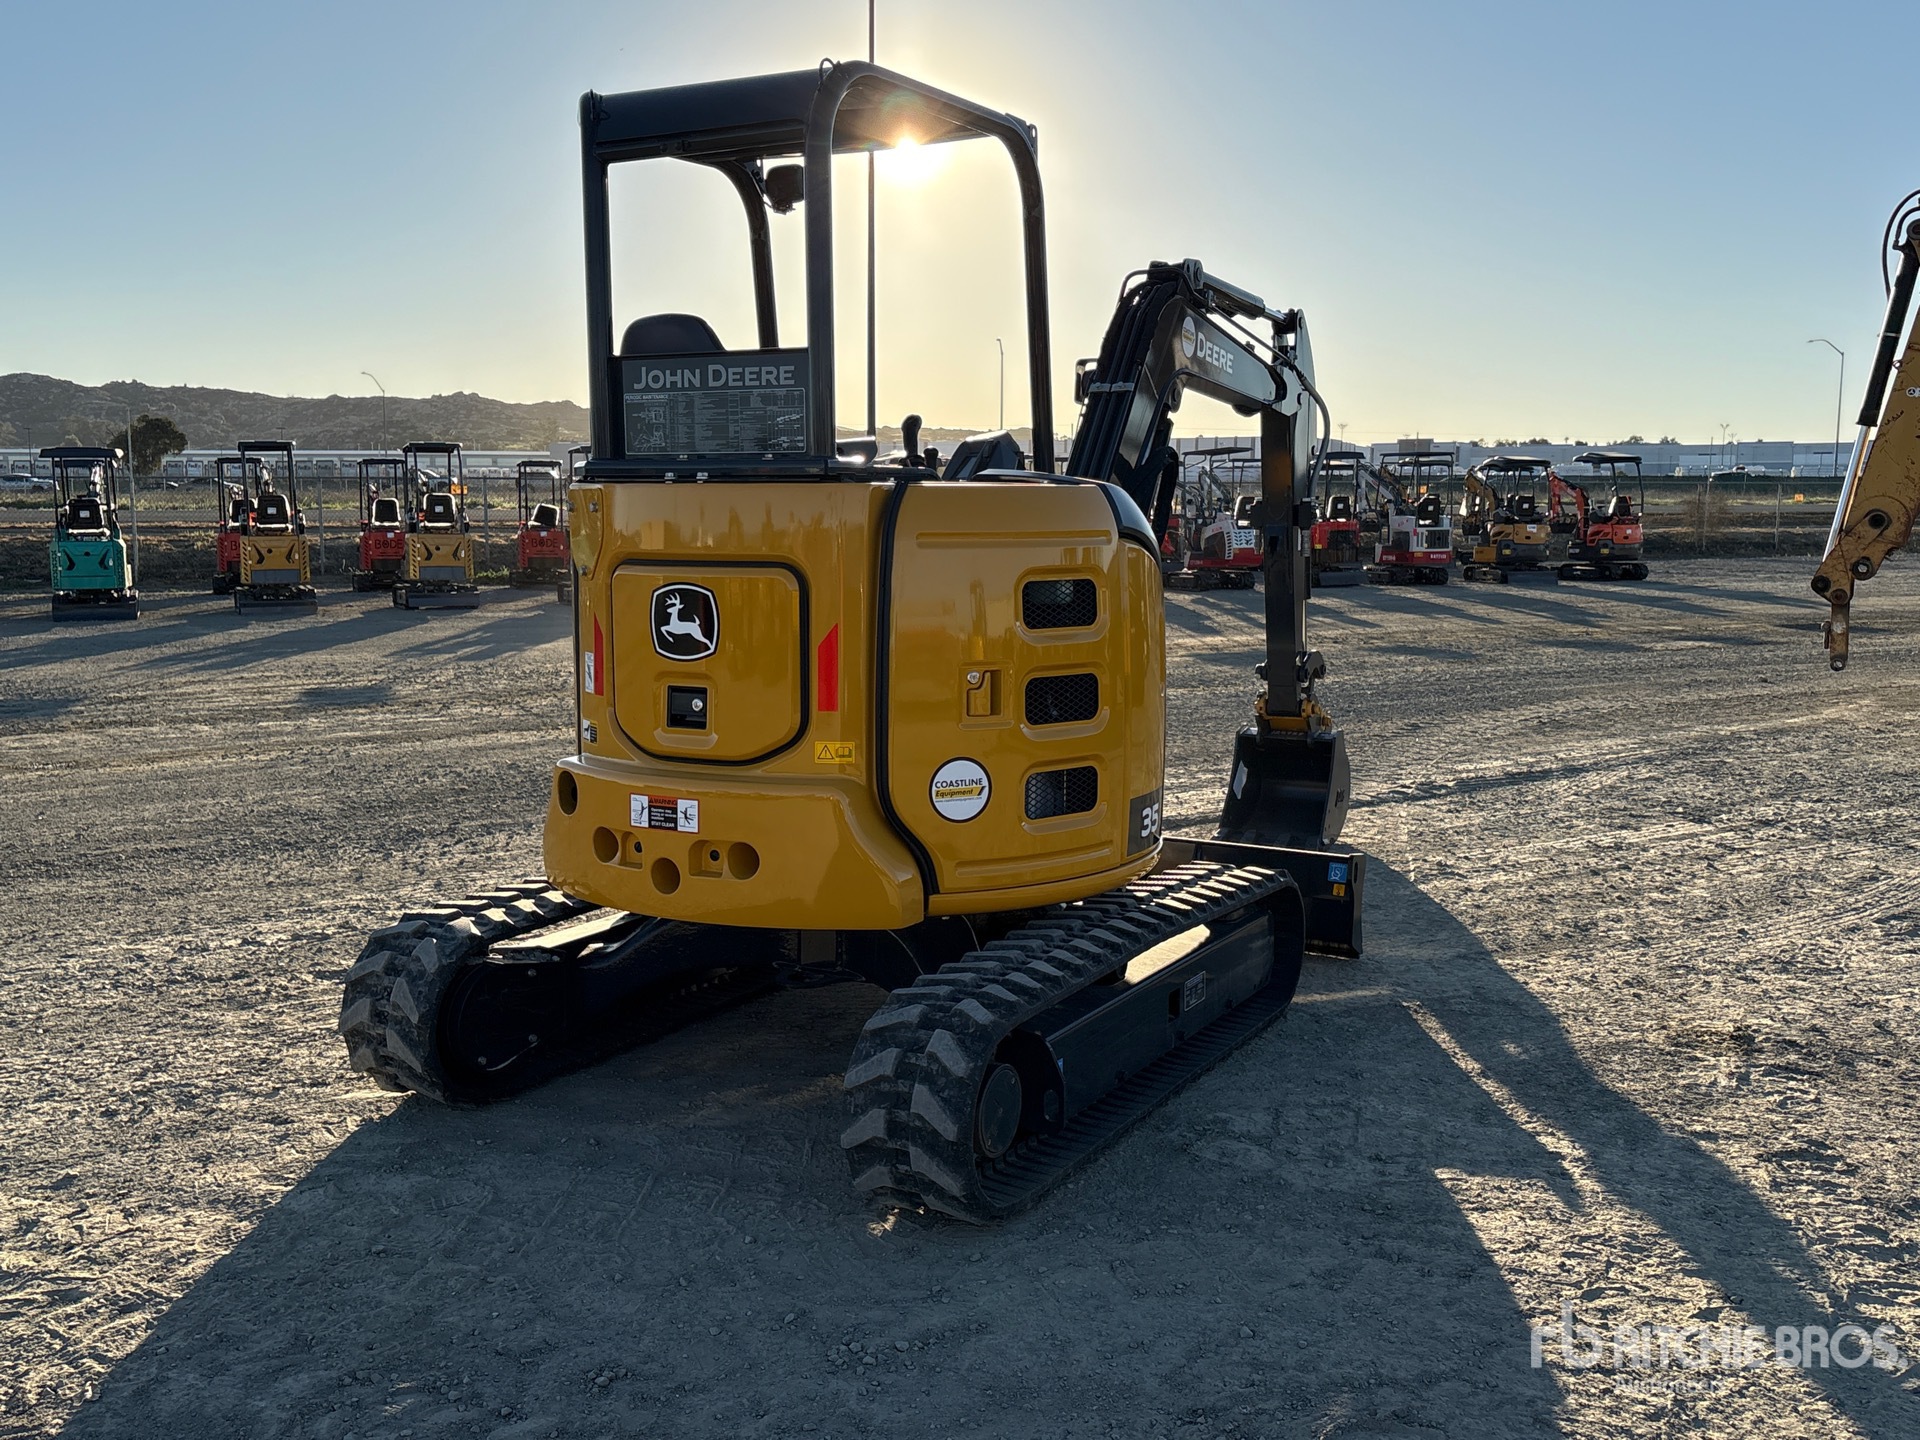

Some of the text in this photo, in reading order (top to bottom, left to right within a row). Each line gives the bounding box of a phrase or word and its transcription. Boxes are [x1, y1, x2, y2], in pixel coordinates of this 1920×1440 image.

[1197, 332, 1233, 374] DEERE
[633, 364, 795, 389] JOHN DEERE
[934, 778, 983, 789] COASTLINE
[935, 789, 973, 798] Equipment
[1141, 802, 1159, 838] 35
